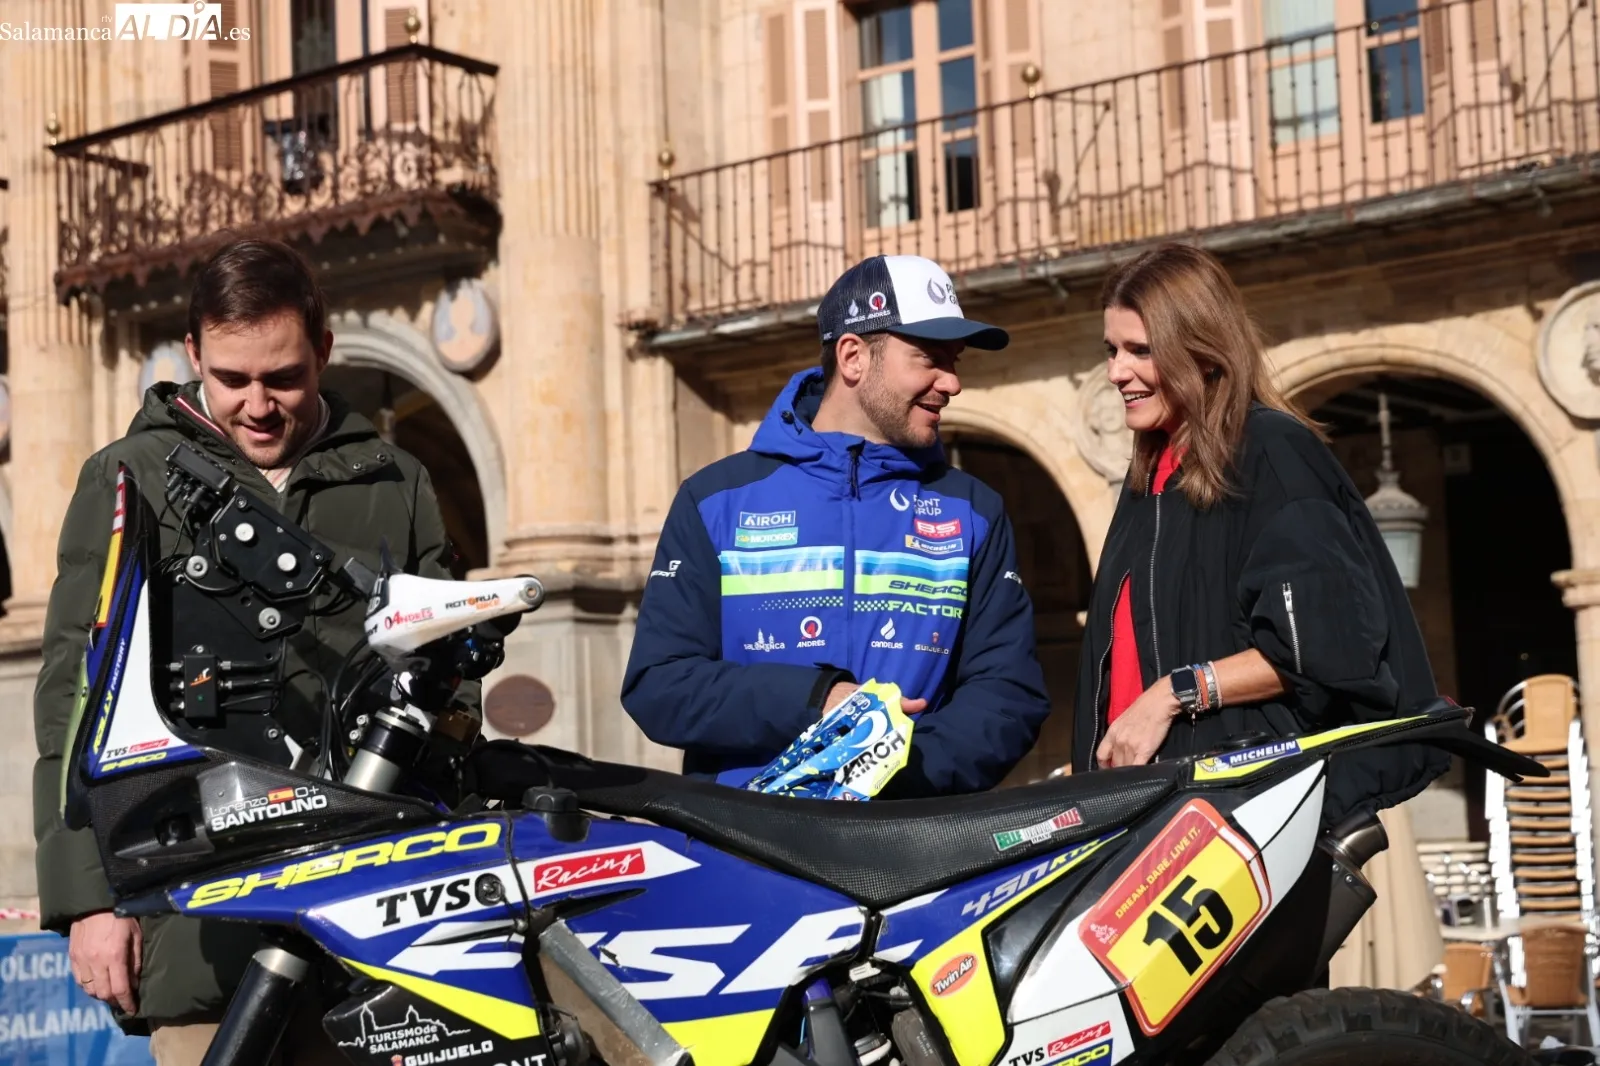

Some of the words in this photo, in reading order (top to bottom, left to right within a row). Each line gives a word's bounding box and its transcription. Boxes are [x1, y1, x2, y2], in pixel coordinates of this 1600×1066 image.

[744, 513, 792, 526] AIROH
[917, 520, 957, 534] BS
[750, 532, 797, 544] MOTOREX
[887, 600, 963, 619] FACTOR
[871, 640, 904, 649] CANDELAS
[110, 638, 125, 691] FACTORY
[106, 746, 128, 759] TVS
[1230, 740, 1296, 764] MICHELIN
[209, 796, 268, 818] Lorenzo
[211, 794, 328, 833] SANTOLINO
[186, 822, 502, 909] SHERCO
[536, 852, 642, 891] Racing
[1115, 884, 1149, 919] DREAM.
[1146, 858, 1172, 885] DARE.
[1170, 838, 1190, 860] LIVE
[376, 878, 471, 927] TVS
[1143, 874, 1234, 976] 15
[933, 969, 959, 995] Twin
[958, 955, 975, 976] Air
[369, 1034, 440, 1054] SALAMANCA
[1049, 1022, 1109, 1057] Racing
[405, 1040, 494, 1066] GUIJUELO
